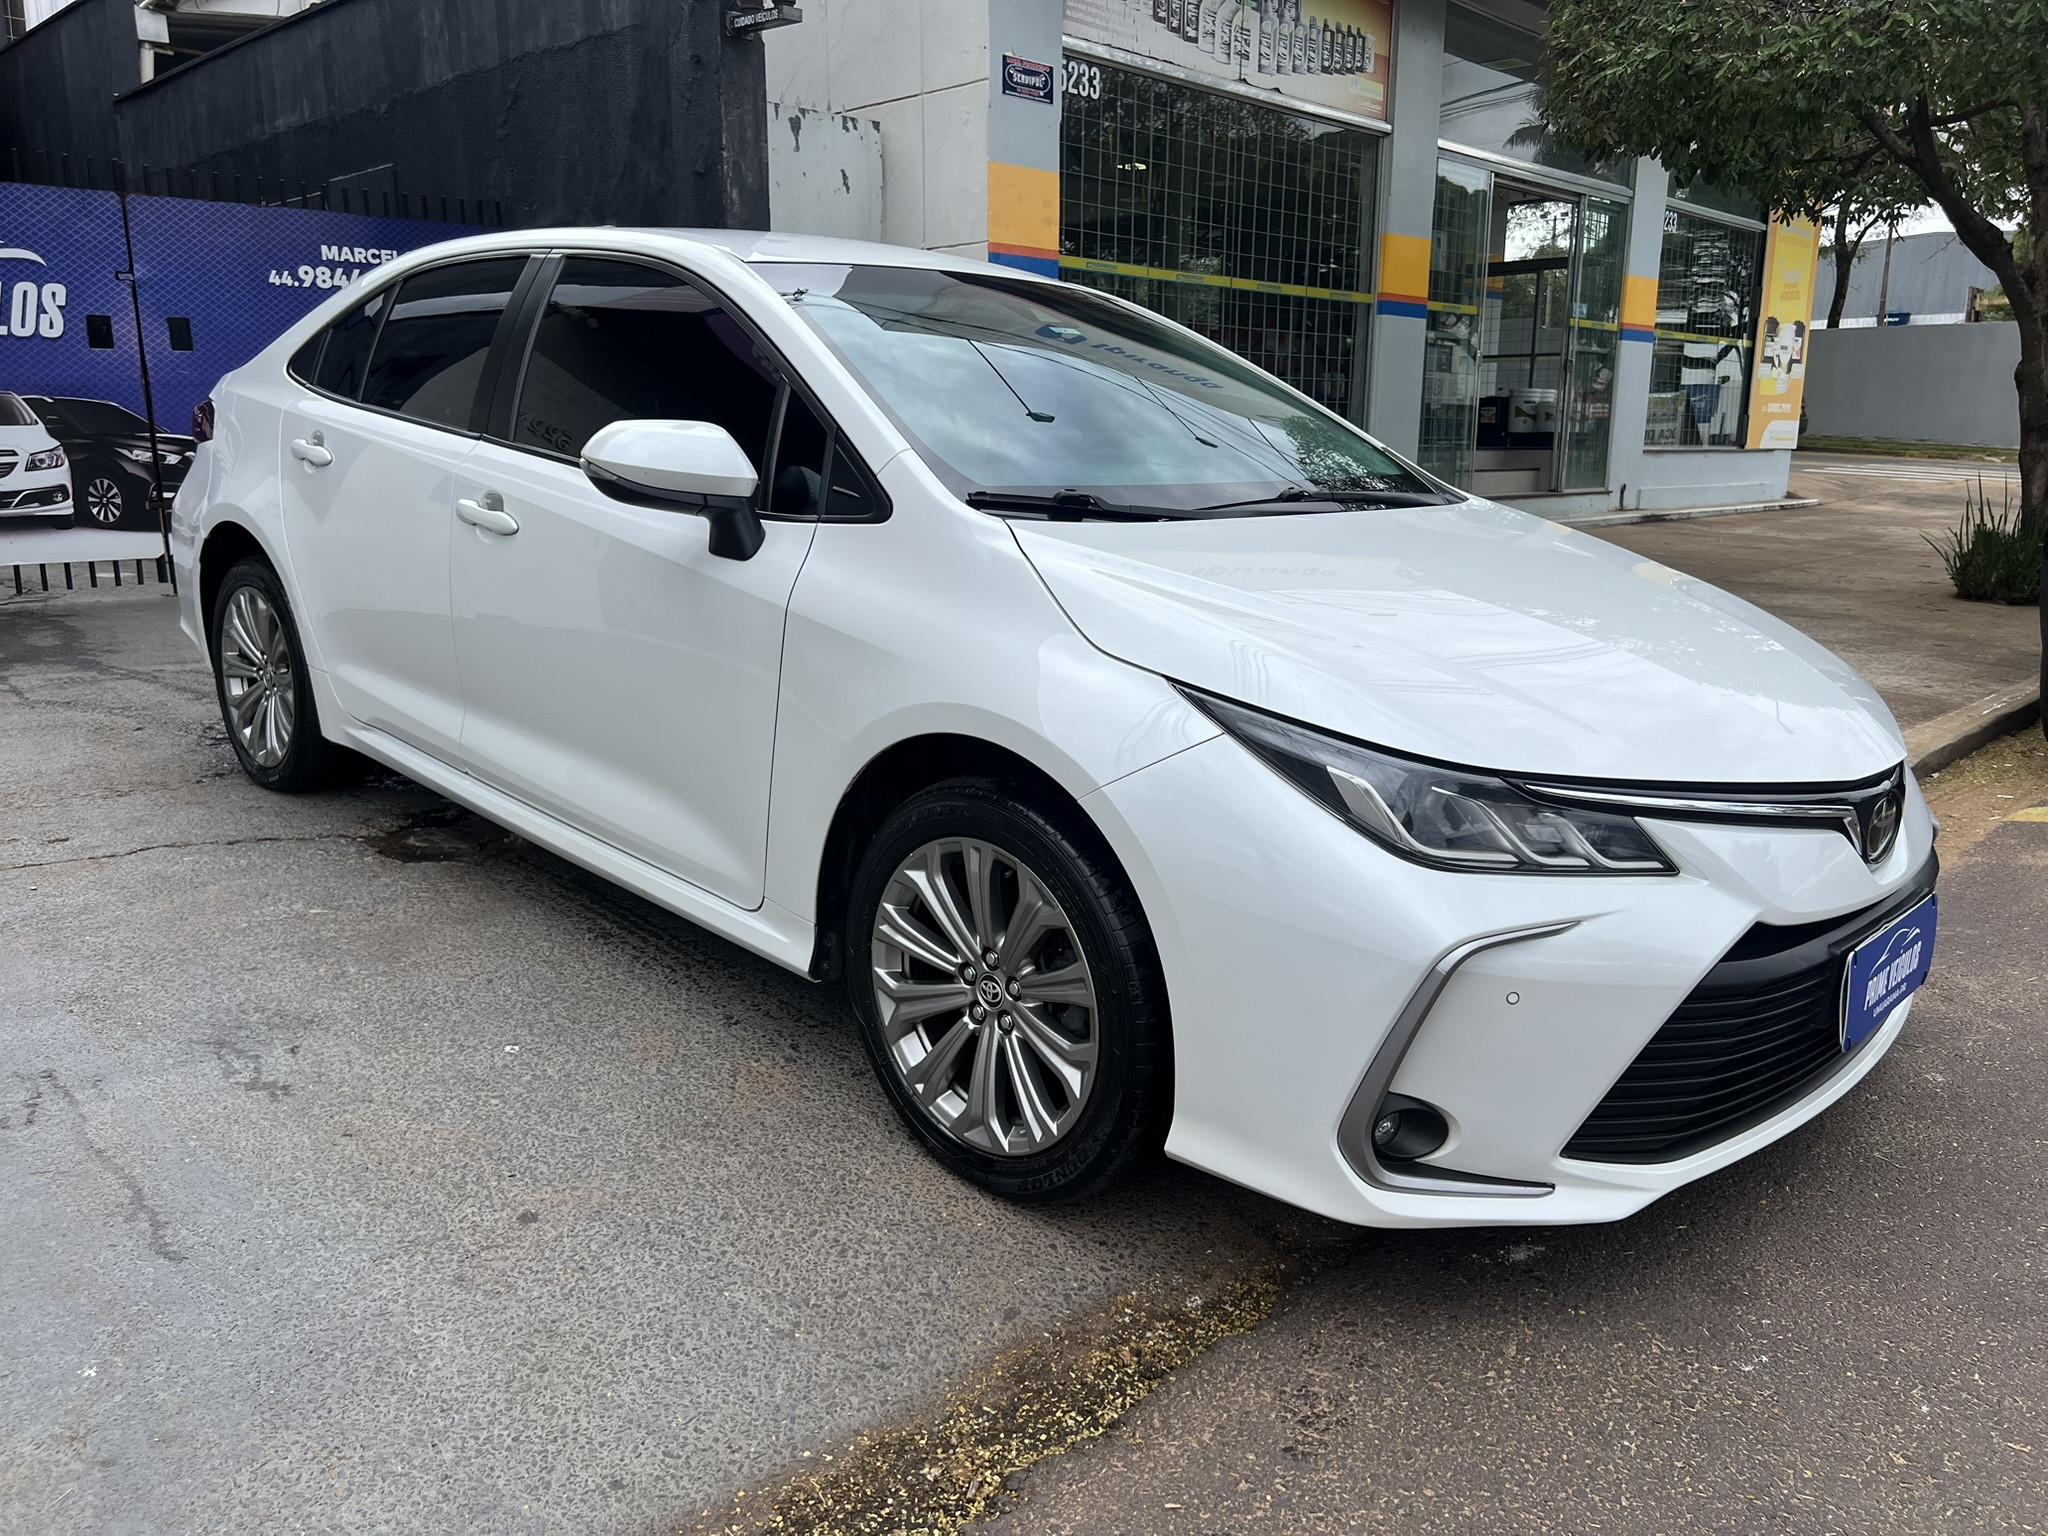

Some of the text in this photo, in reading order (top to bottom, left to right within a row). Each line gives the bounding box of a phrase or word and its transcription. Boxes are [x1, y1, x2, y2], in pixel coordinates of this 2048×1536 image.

[734, 15, 754, 27] CUIDADO
[0, 281, 67, 338] OS
[1864, 966, 1890, 1011] PRIME
